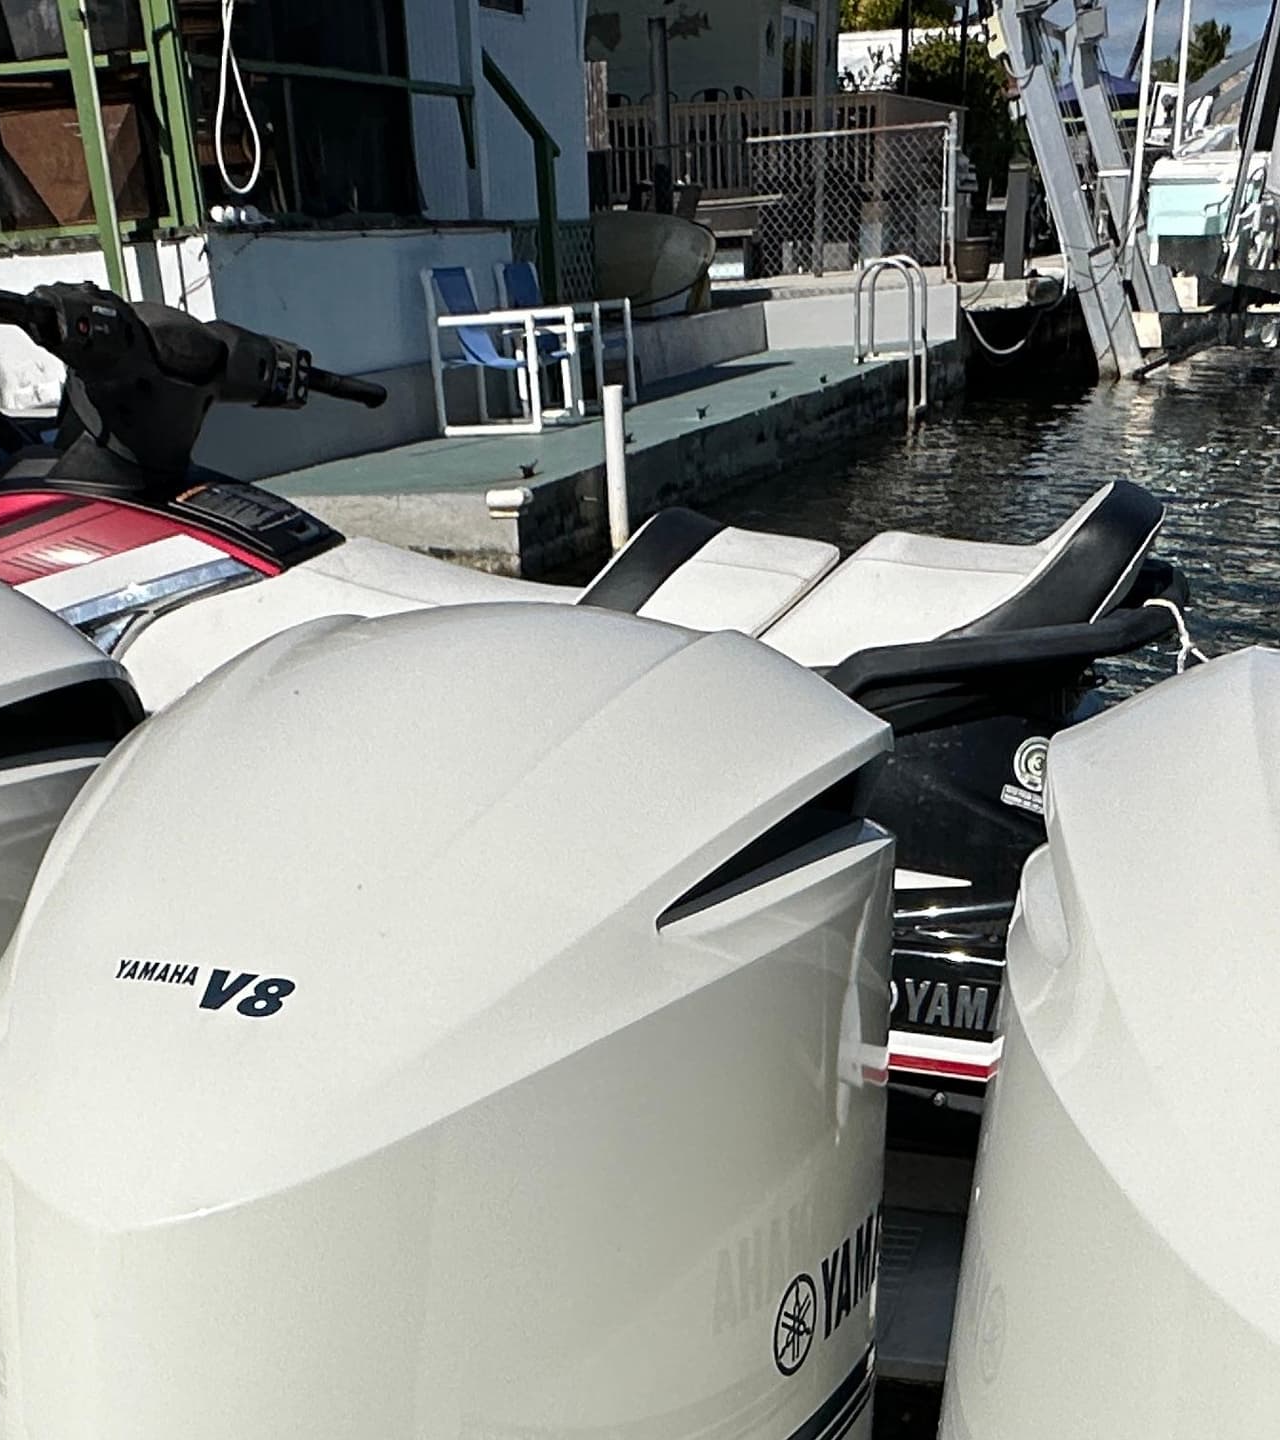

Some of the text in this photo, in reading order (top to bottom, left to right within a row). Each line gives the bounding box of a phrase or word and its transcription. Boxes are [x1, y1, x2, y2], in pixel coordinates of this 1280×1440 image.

[115, 959, 296, 1017] YAMAHA V8
[821, 1200, 881, 1341] YAM
